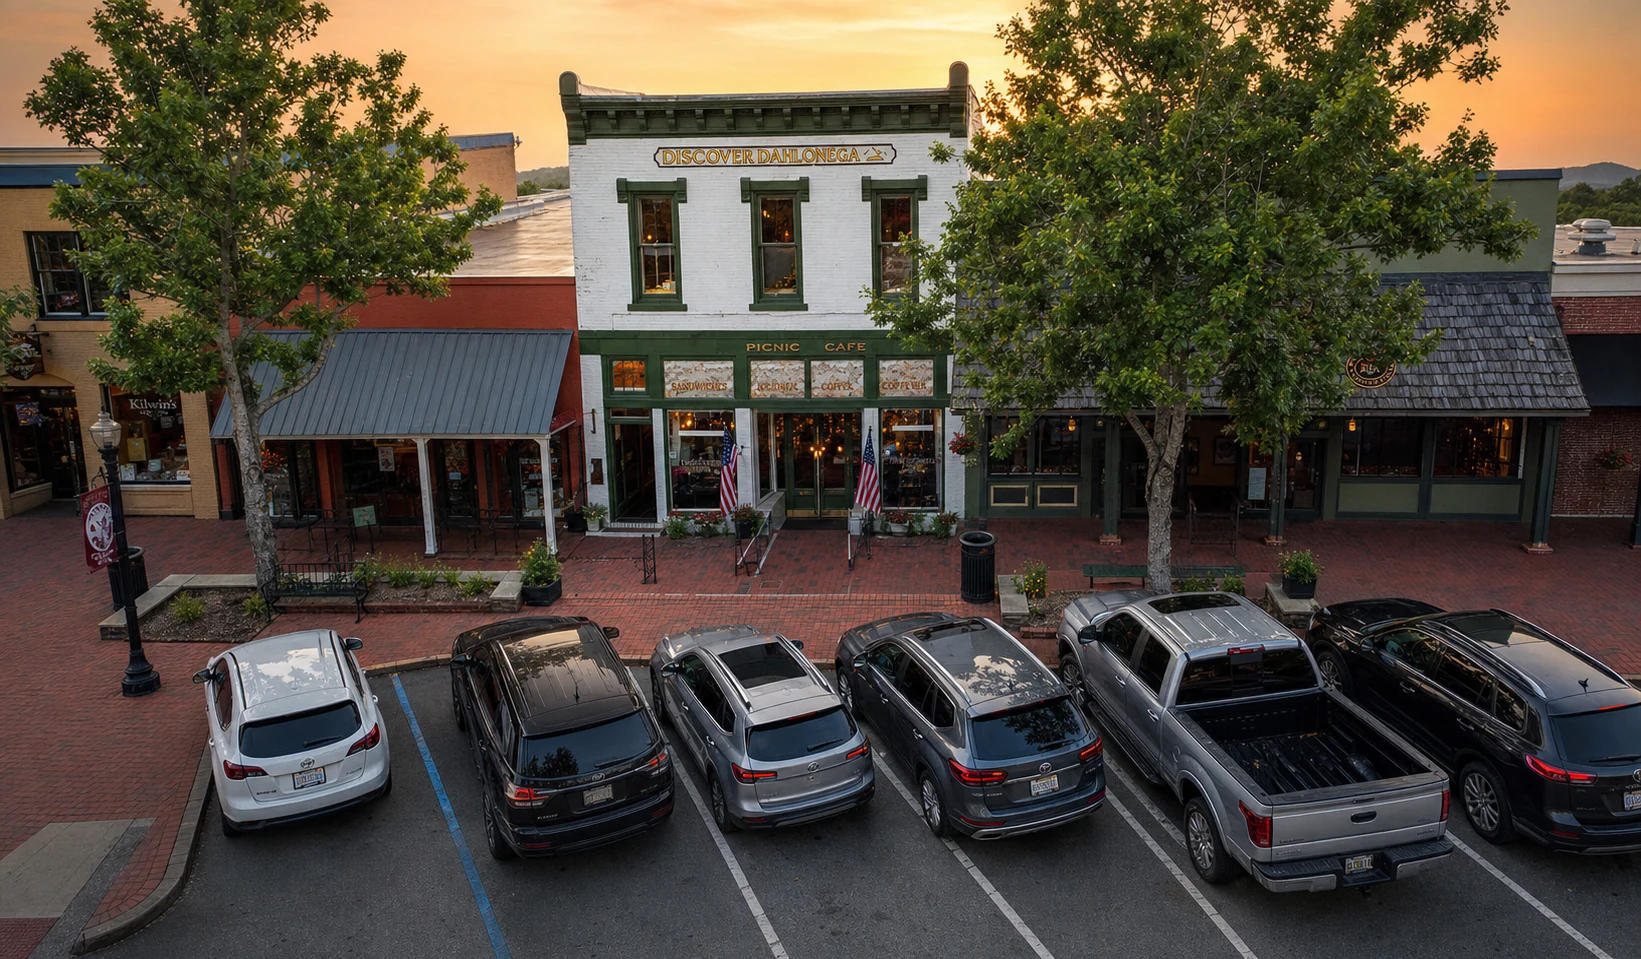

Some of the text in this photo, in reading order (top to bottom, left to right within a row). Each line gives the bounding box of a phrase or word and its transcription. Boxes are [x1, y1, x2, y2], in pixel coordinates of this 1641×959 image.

[662, 147, 861, 165] DISCOVER DAHLONEGA
[746, 342, 867, 352] PICNIC CAFE
[128, 398, 178, 410] Kilwin's
